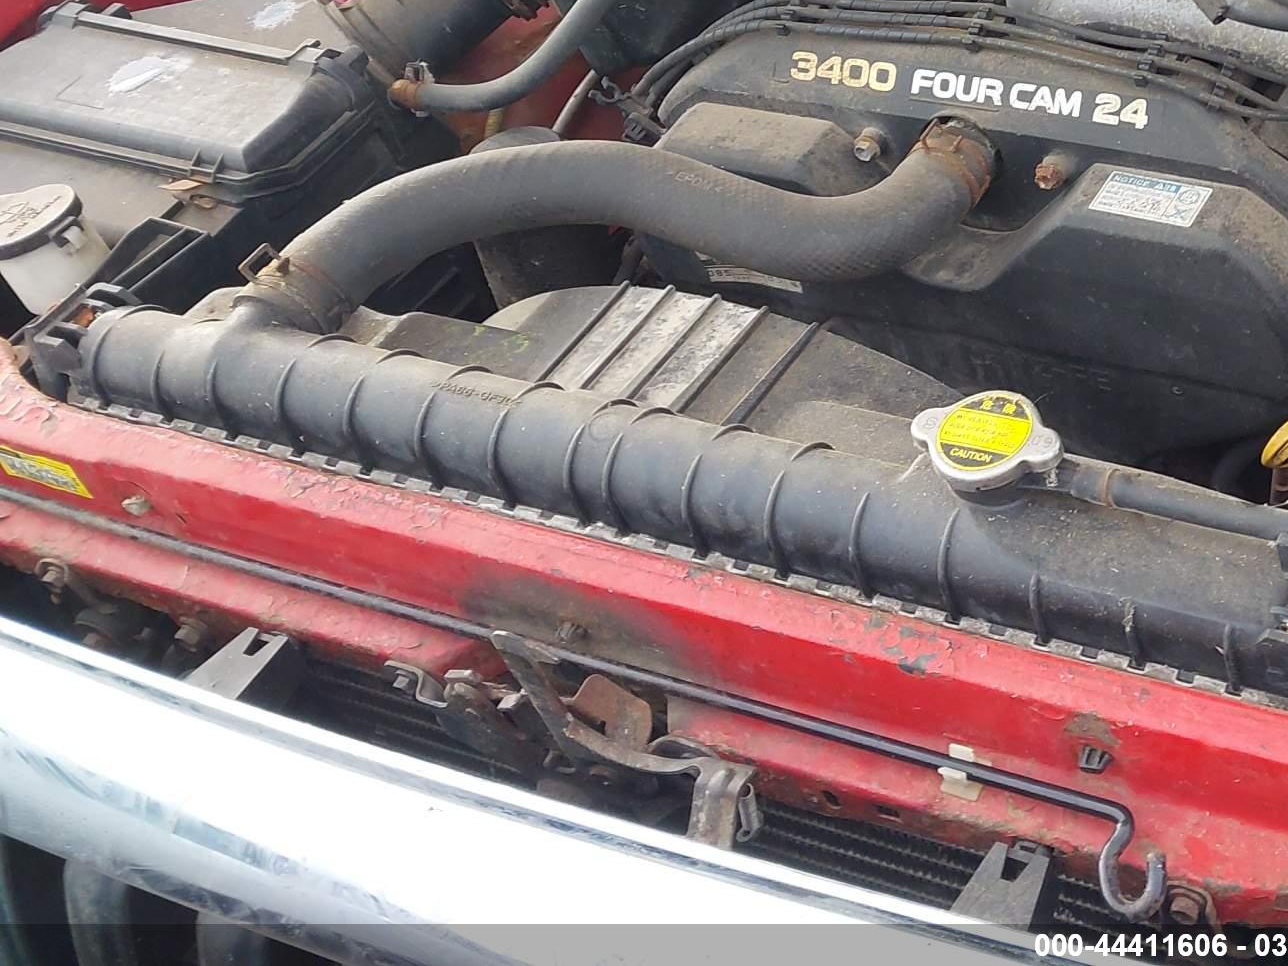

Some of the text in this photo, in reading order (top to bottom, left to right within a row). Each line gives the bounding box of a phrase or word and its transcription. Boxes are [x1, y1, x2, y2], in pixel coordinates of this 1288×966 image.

[789, 50, 1150, 131] 3400 FOUR CAM 24
[950, 447, 993, 463] CAUTION
